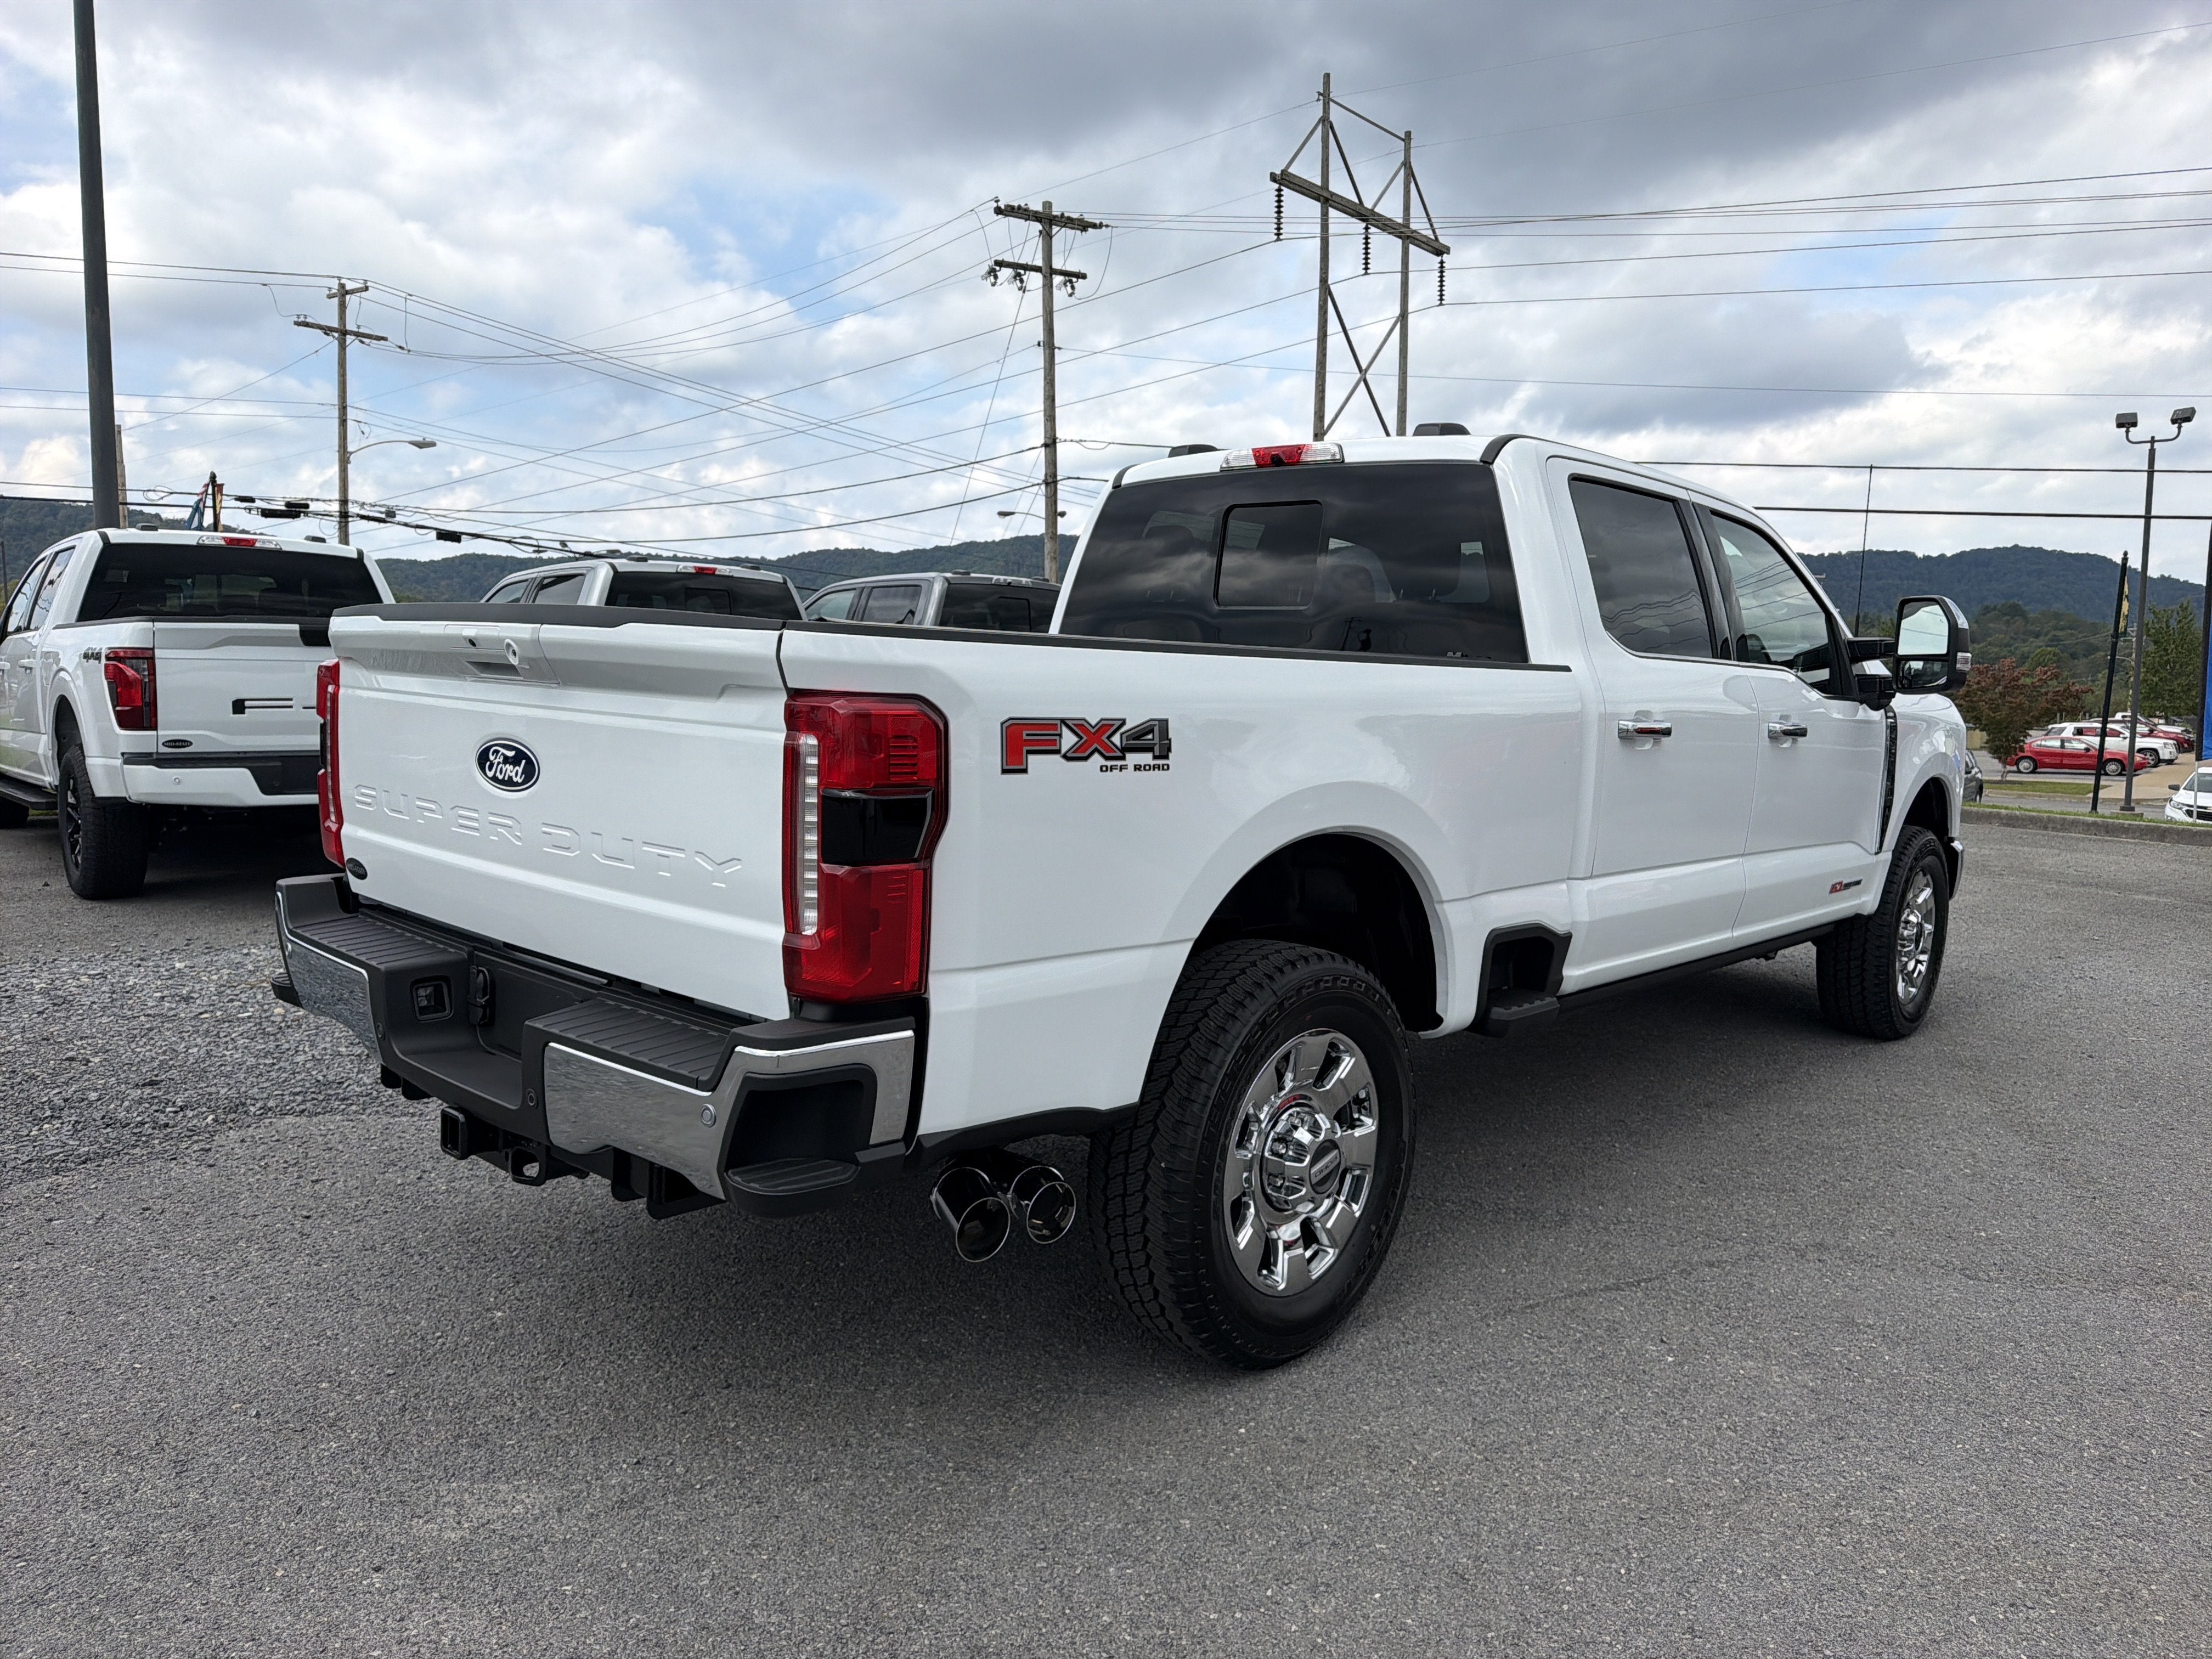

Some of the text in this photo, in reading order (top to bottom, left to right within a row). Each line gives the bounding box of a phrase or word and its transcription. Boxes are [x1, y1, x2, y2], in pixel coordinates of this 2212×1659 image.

[486, 746, 526, 783] Ford
[1001, 717, 1172, 775] FX4
[1099, 763, 1170, 772] OFF ROAD
[354, 785, 741, 887] SUPER DUTY
